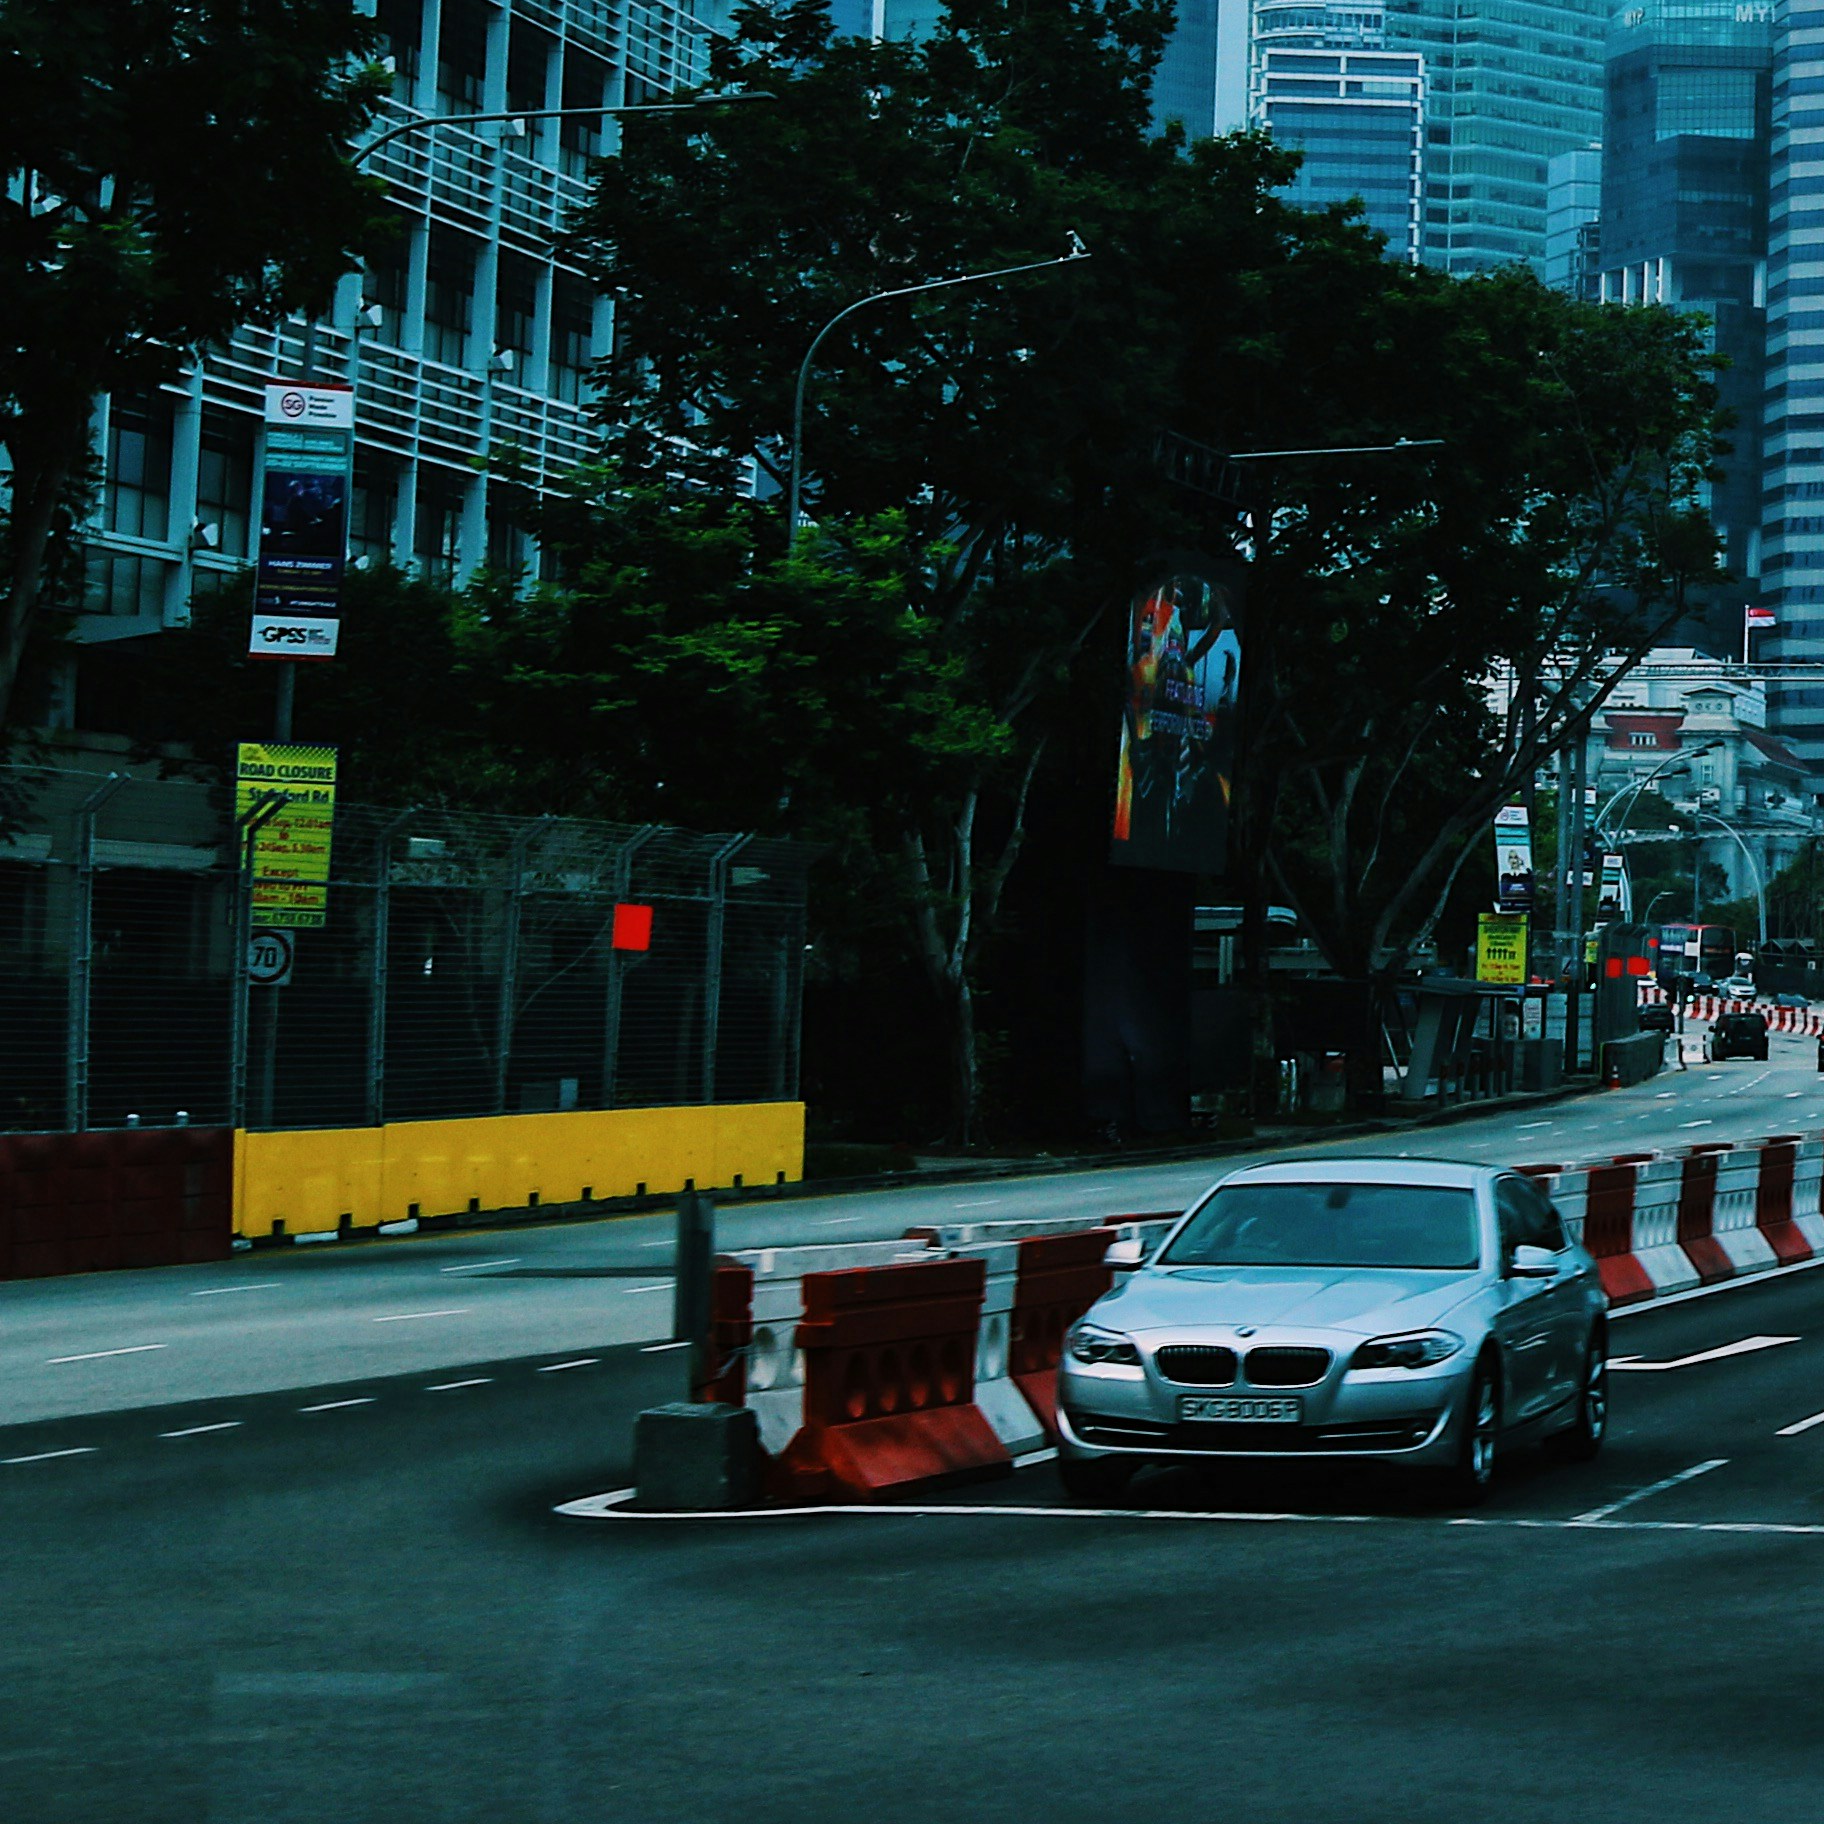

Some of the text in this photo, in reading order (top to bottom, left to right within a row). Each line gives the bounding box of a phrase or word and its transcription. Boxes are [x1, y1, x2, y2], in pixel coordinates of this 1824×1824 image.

[261, 626, 308, 644] GPSS
[240, 762, 333, 780] ROAD CLOSURE
[313, 789, 330, 804] Rd
[251, 946, 278, 968] 70
